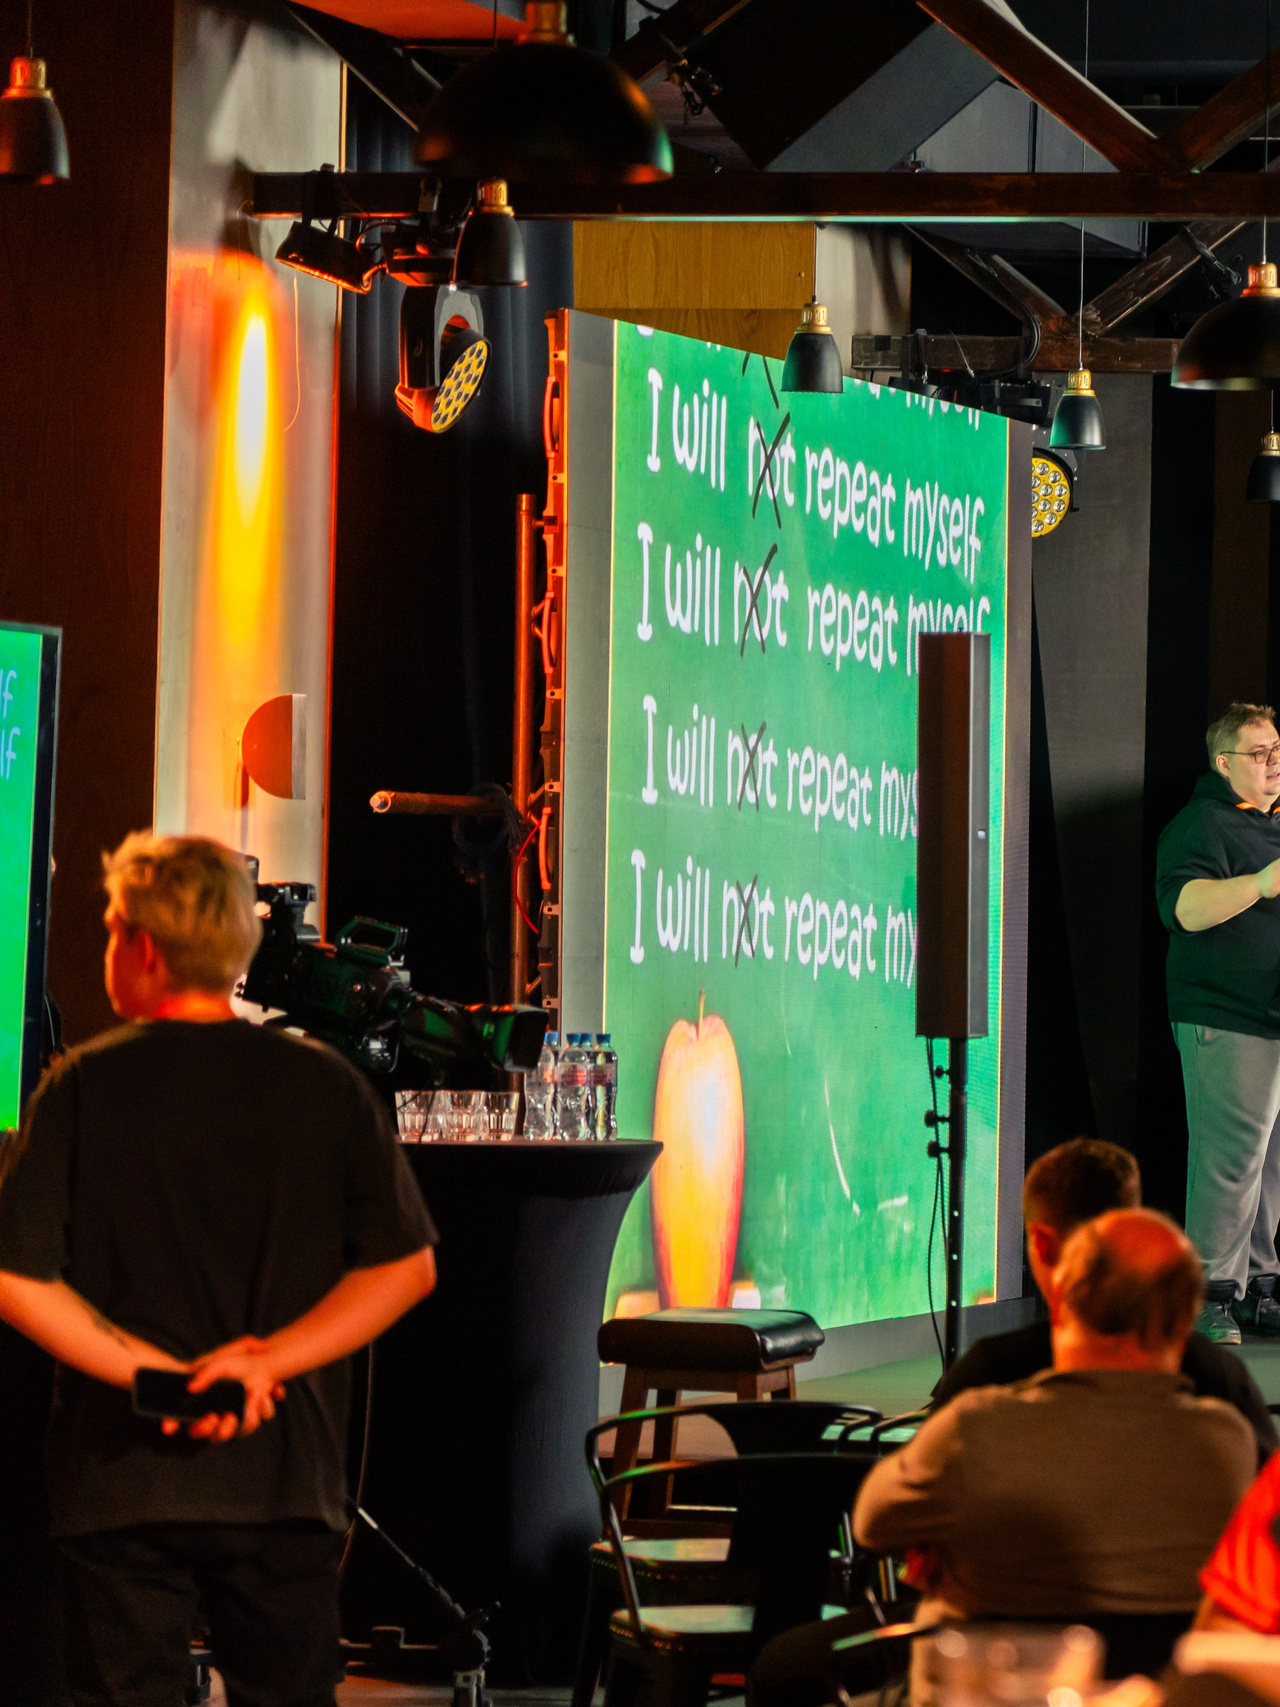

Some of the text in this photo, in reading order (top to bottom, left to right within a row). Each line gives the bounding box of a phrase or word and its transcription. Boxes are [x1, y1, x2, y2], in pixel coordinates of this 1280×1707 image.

[647, 367, 663, 473] I
[672, 377, 727, 493] will
[748, 416, 796, 507] not
[804, 445, 896, 549] repeat
[903, 478, 985, 585] myself
[637, 521, 653, 642] I
[664, 532, 721, 648] will
[733, 560, 789, 648] not
[807, 583, 898, 673] repeat
[642, 694, 658, 806] I
[667, 703, 715, 809] will
[726, 728, 778, 809] not
[787, 745, 873, 835] repeat
[630, 848, 646, 965] I
[656, 855, 710, 964] will
[722, 880, 775, 961] not
[785, 892, 878, 982] repeat
